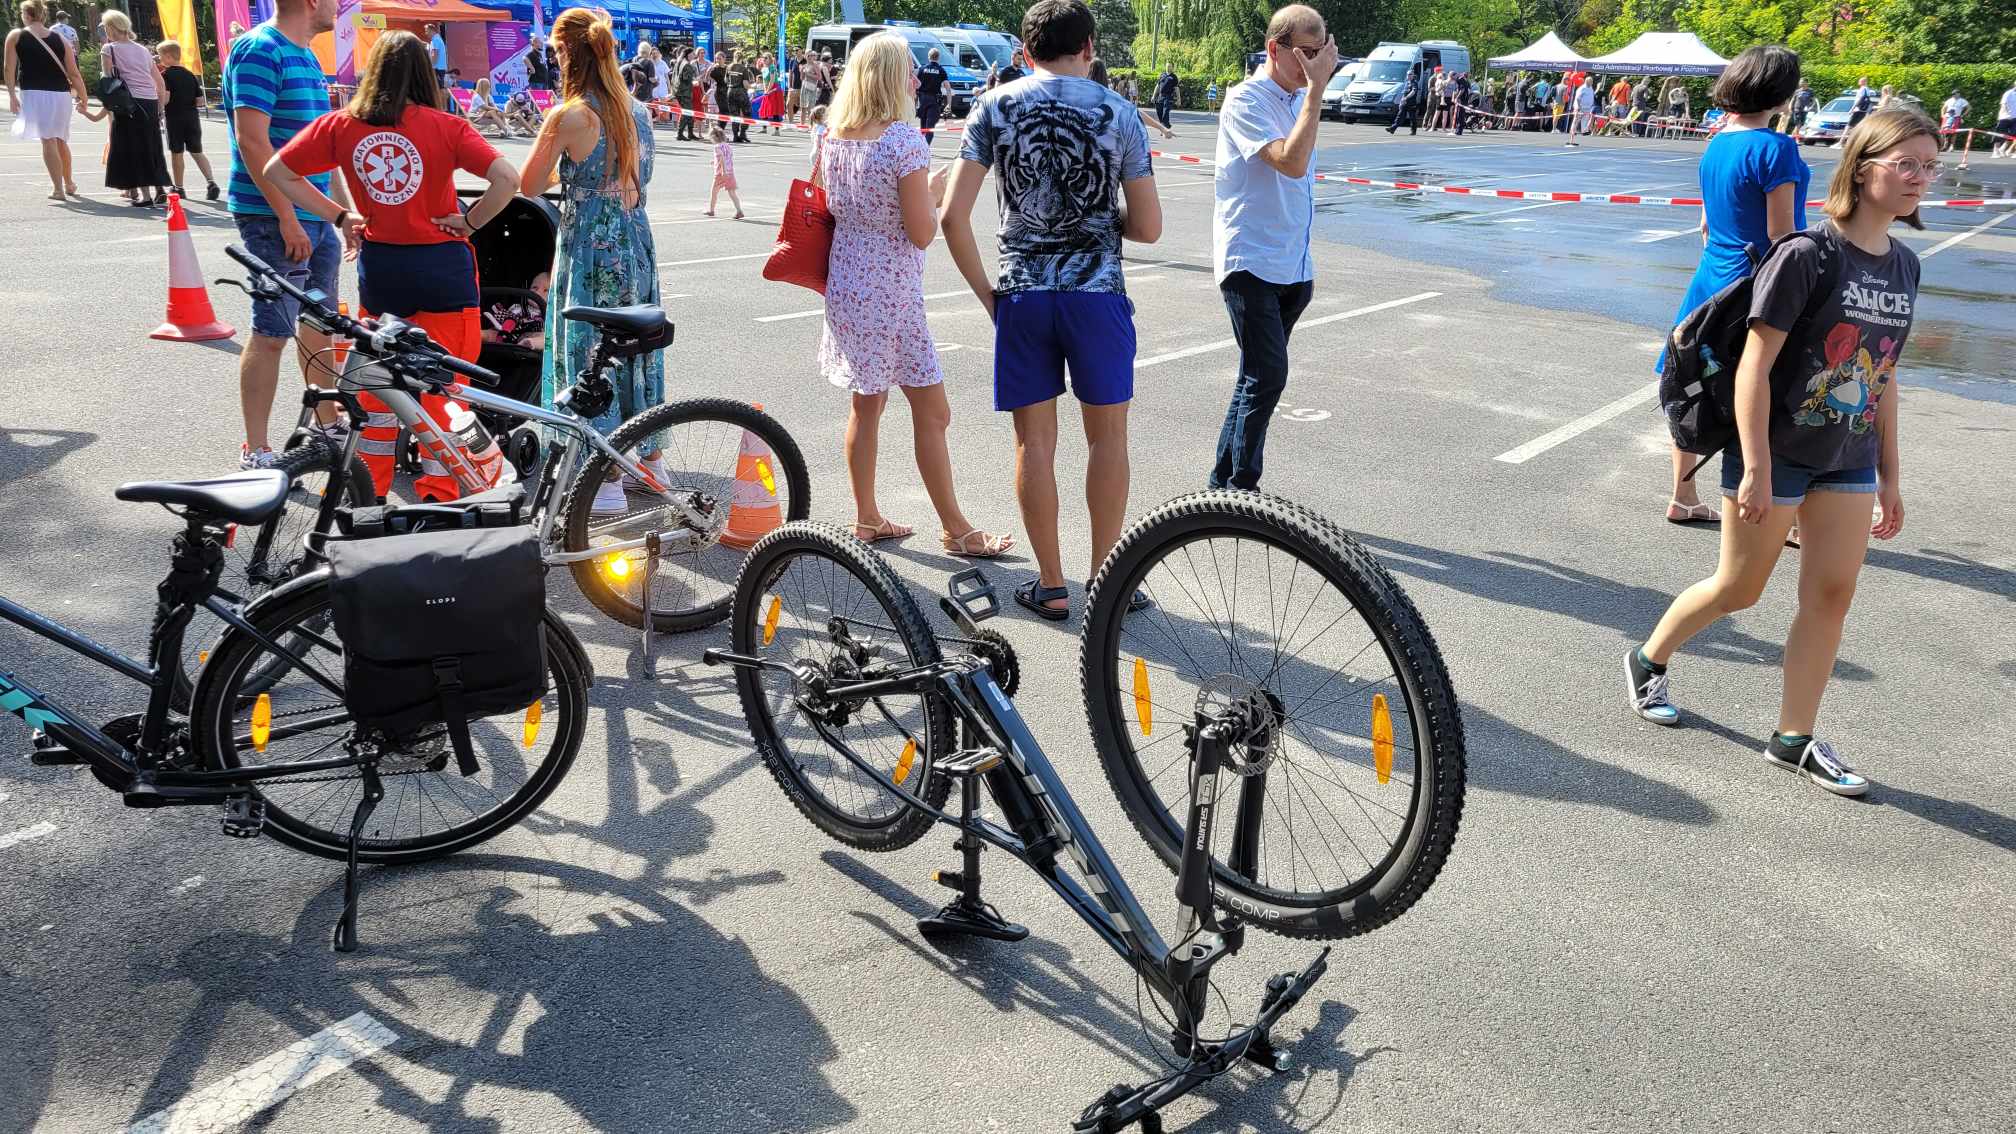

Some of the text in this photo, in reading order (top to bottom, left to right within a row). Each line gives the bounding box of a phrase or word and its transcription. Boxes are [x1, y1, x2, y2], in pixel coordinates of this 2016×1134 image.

[354, 133, 420, 165] RATOWNICTWO
[1861, 270, 1889, 288] Disney
[1841, 281, 1911, 314] ALICE
[1844, 310, 1908, 328] WONDERLAND
[761, 736, 805, 802] XR2 COMP
[1231, 896, 1280, 921] COMP
